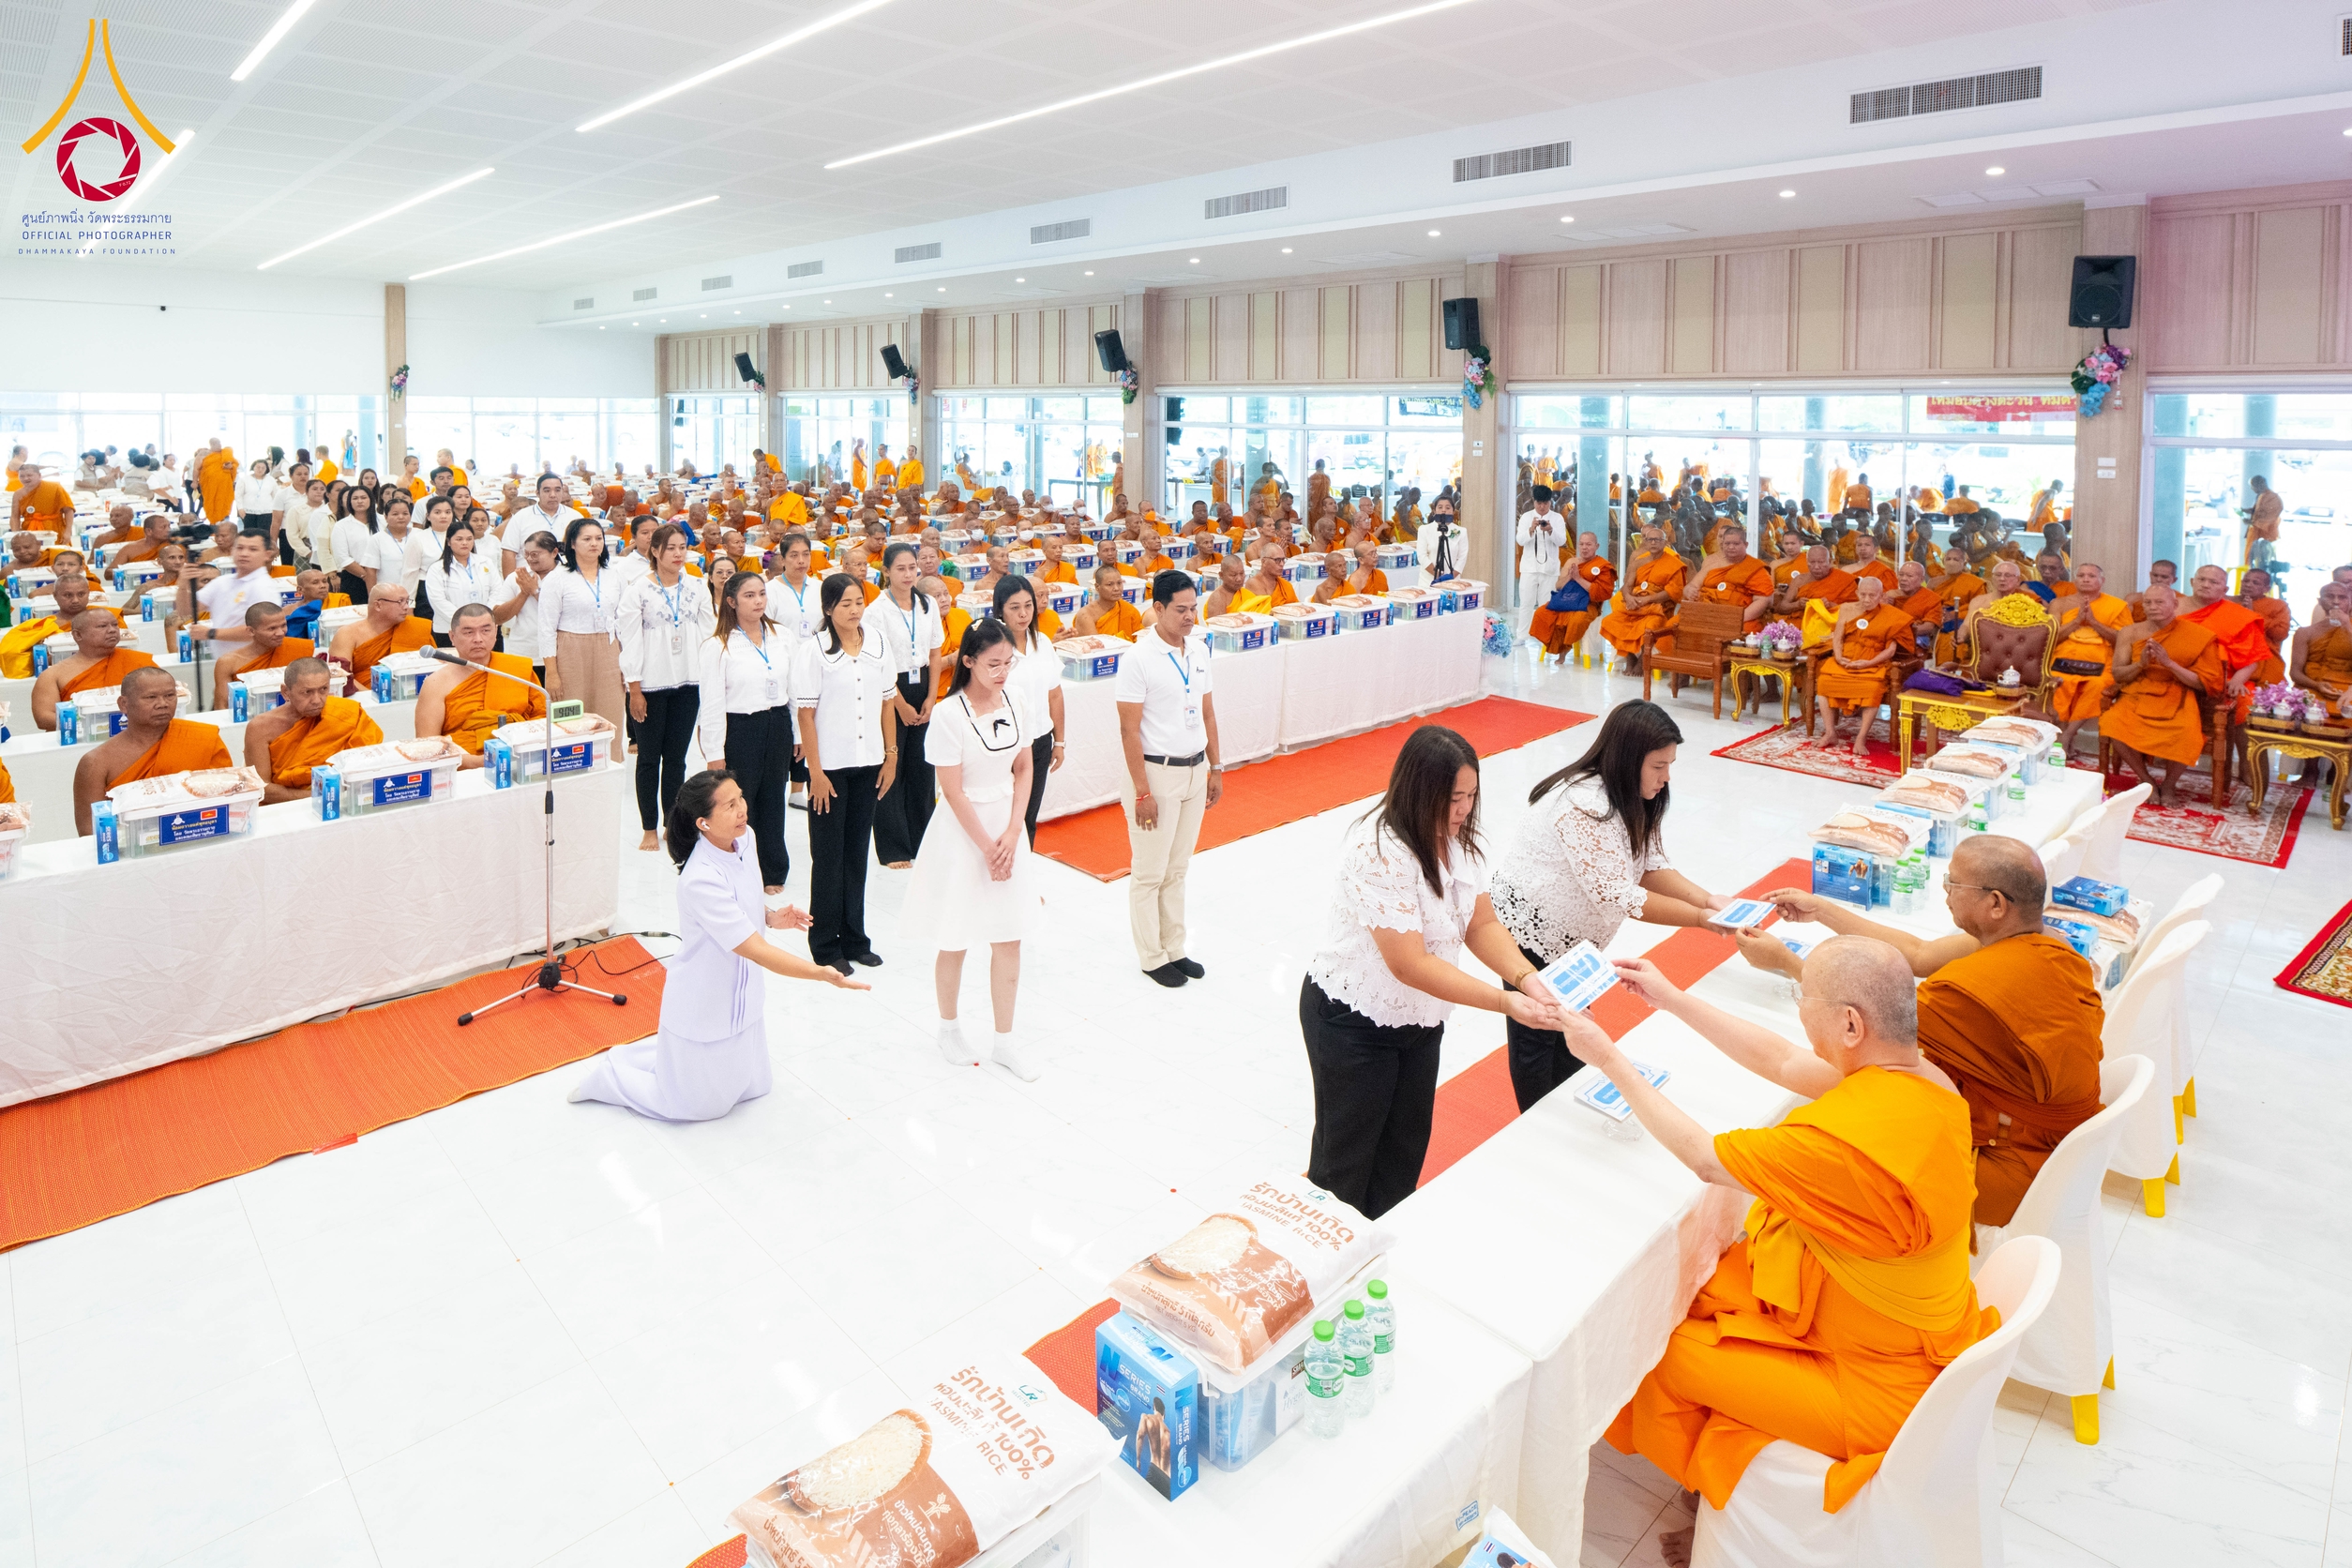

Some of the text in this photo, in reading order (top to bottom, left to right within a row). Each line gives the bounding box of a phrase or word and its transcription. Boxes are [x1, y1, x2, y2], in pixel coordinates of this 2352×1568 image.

[1249, 1181, 1355, 1244] รักบ้านเกิด
[1304, 1220, 1343, 1252] 100%
[1119, 1364, 1152, 1395] SERIES
[1129, 1383, 1151, 1404] BRAND
[950, 1365, 1055, 1469] รักบ้านเกิด
[976, 1440, 1008, 1476] RICE
[994, 1432, 1035, 1480] 100%
